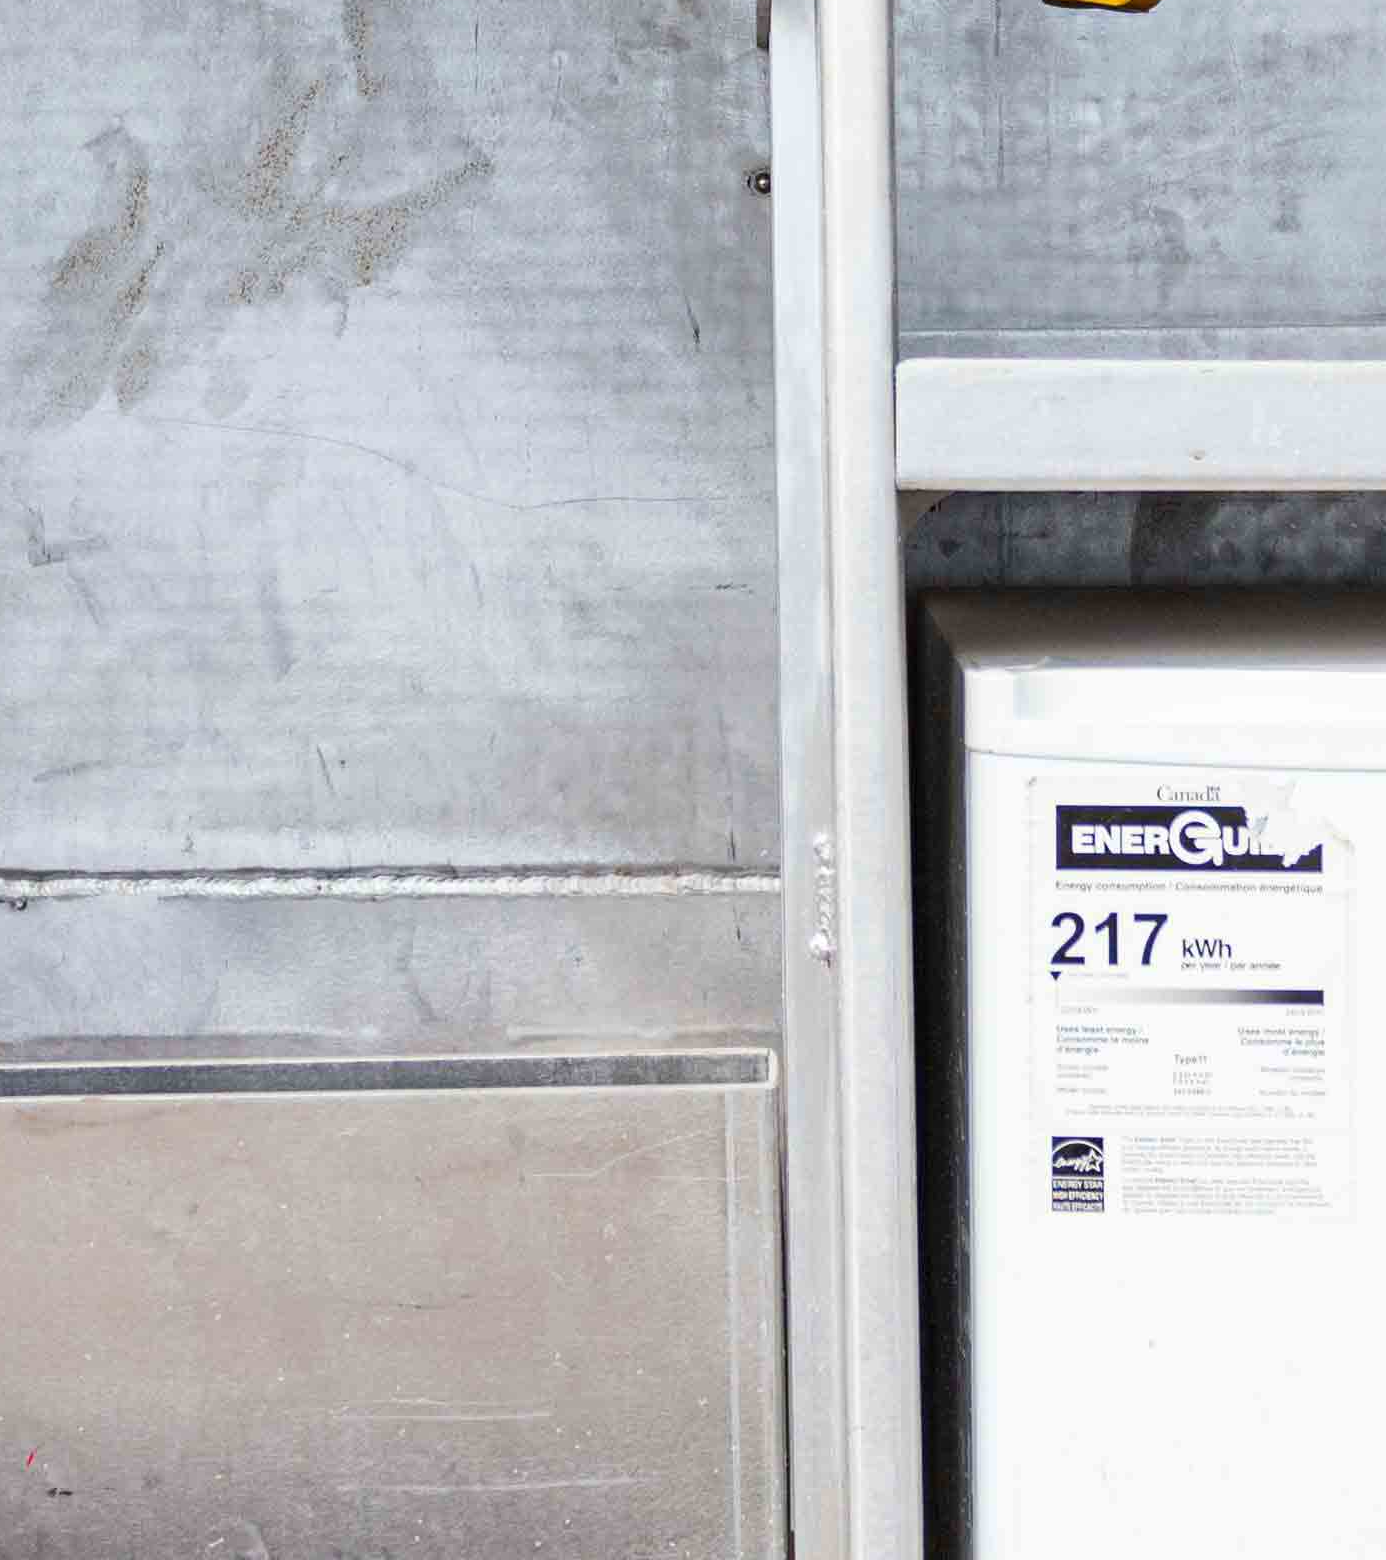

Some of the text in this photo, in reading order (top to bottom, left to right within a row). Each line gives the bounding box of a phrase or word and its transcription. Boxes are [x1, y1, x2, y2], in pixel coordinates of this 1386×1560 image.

[1156, 785, 1221, 802] Canada
[1050, 912, 1233, 966] 217 kWh
